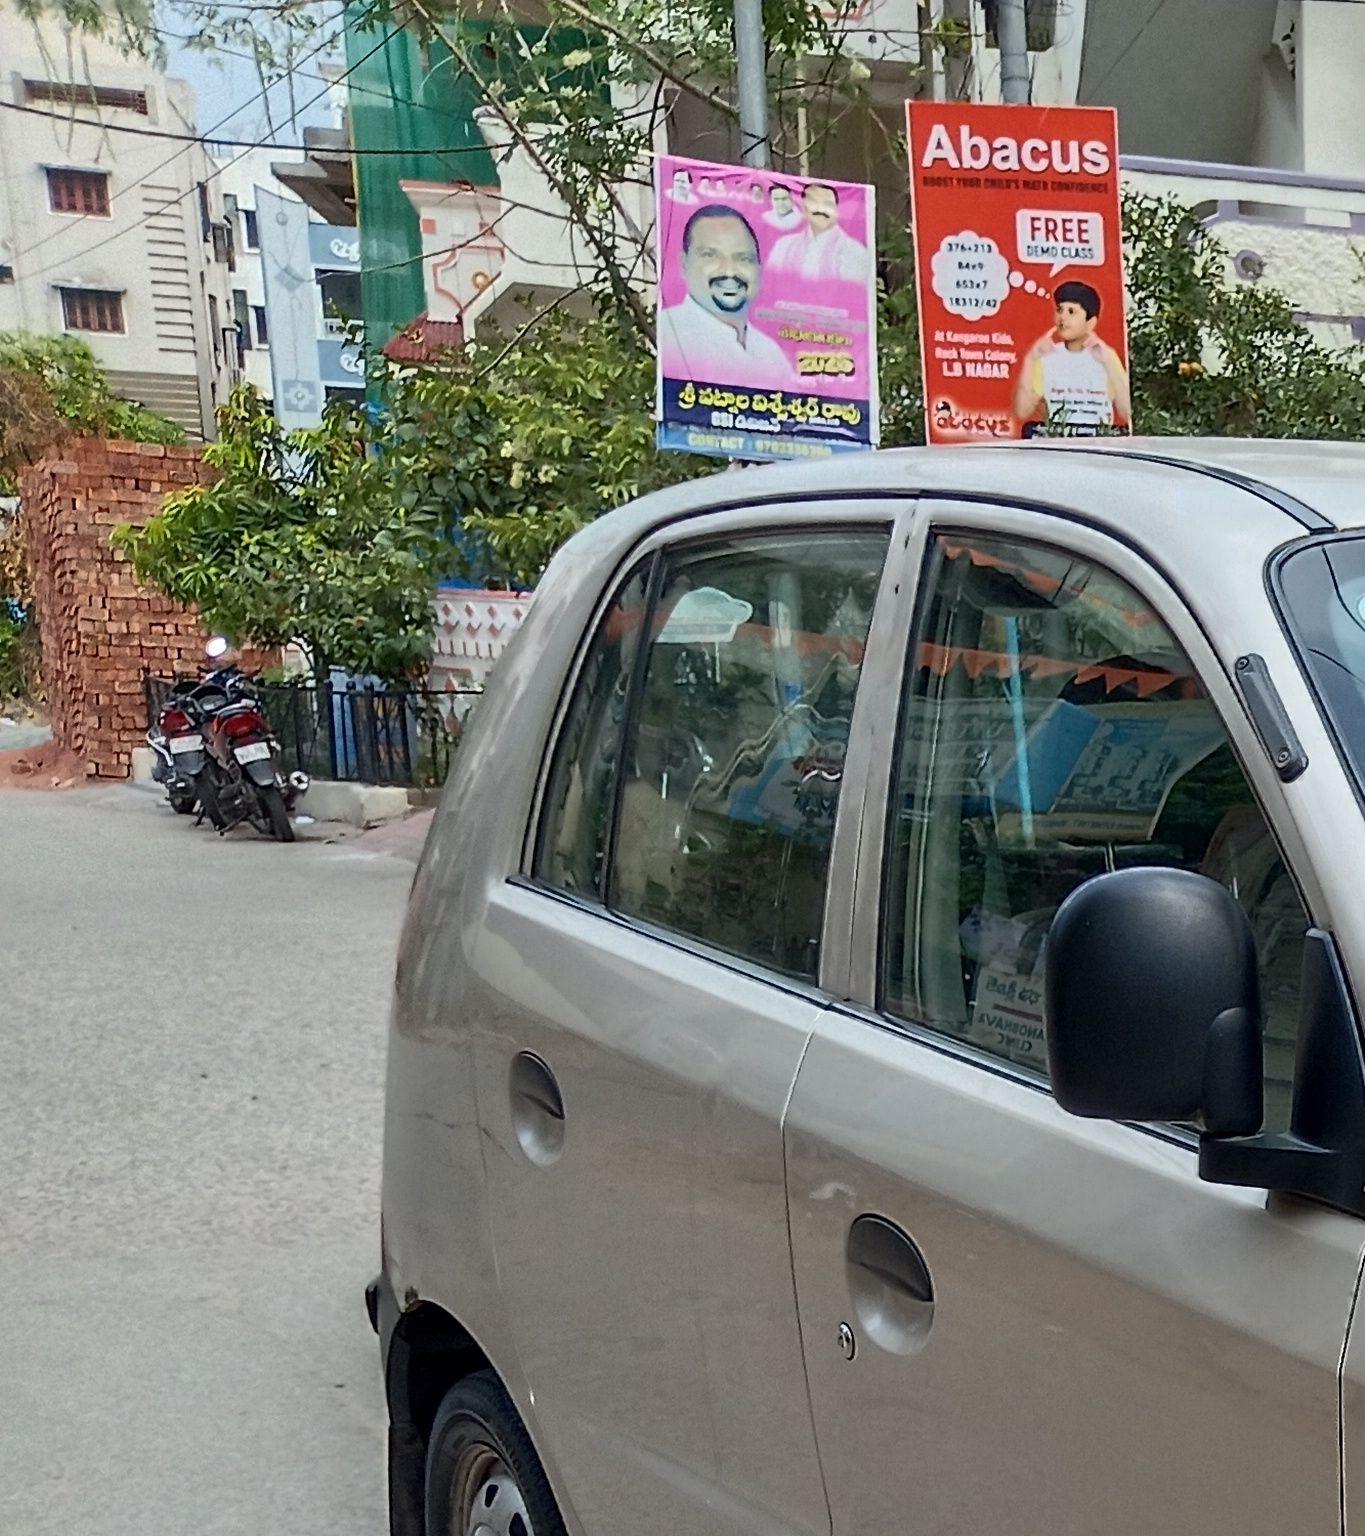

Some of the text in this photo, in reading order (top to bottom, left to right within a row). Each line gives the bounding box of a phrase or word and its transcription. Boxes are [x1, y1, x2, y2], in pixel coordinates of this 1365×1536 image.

[921, 124, 1110, 176] Abacus
[1030, 216, 1090, 244] FREE
[1026, 245, 1094, 259] DEMO CLASS
[965, 362, 1010, 379] NAGAR
